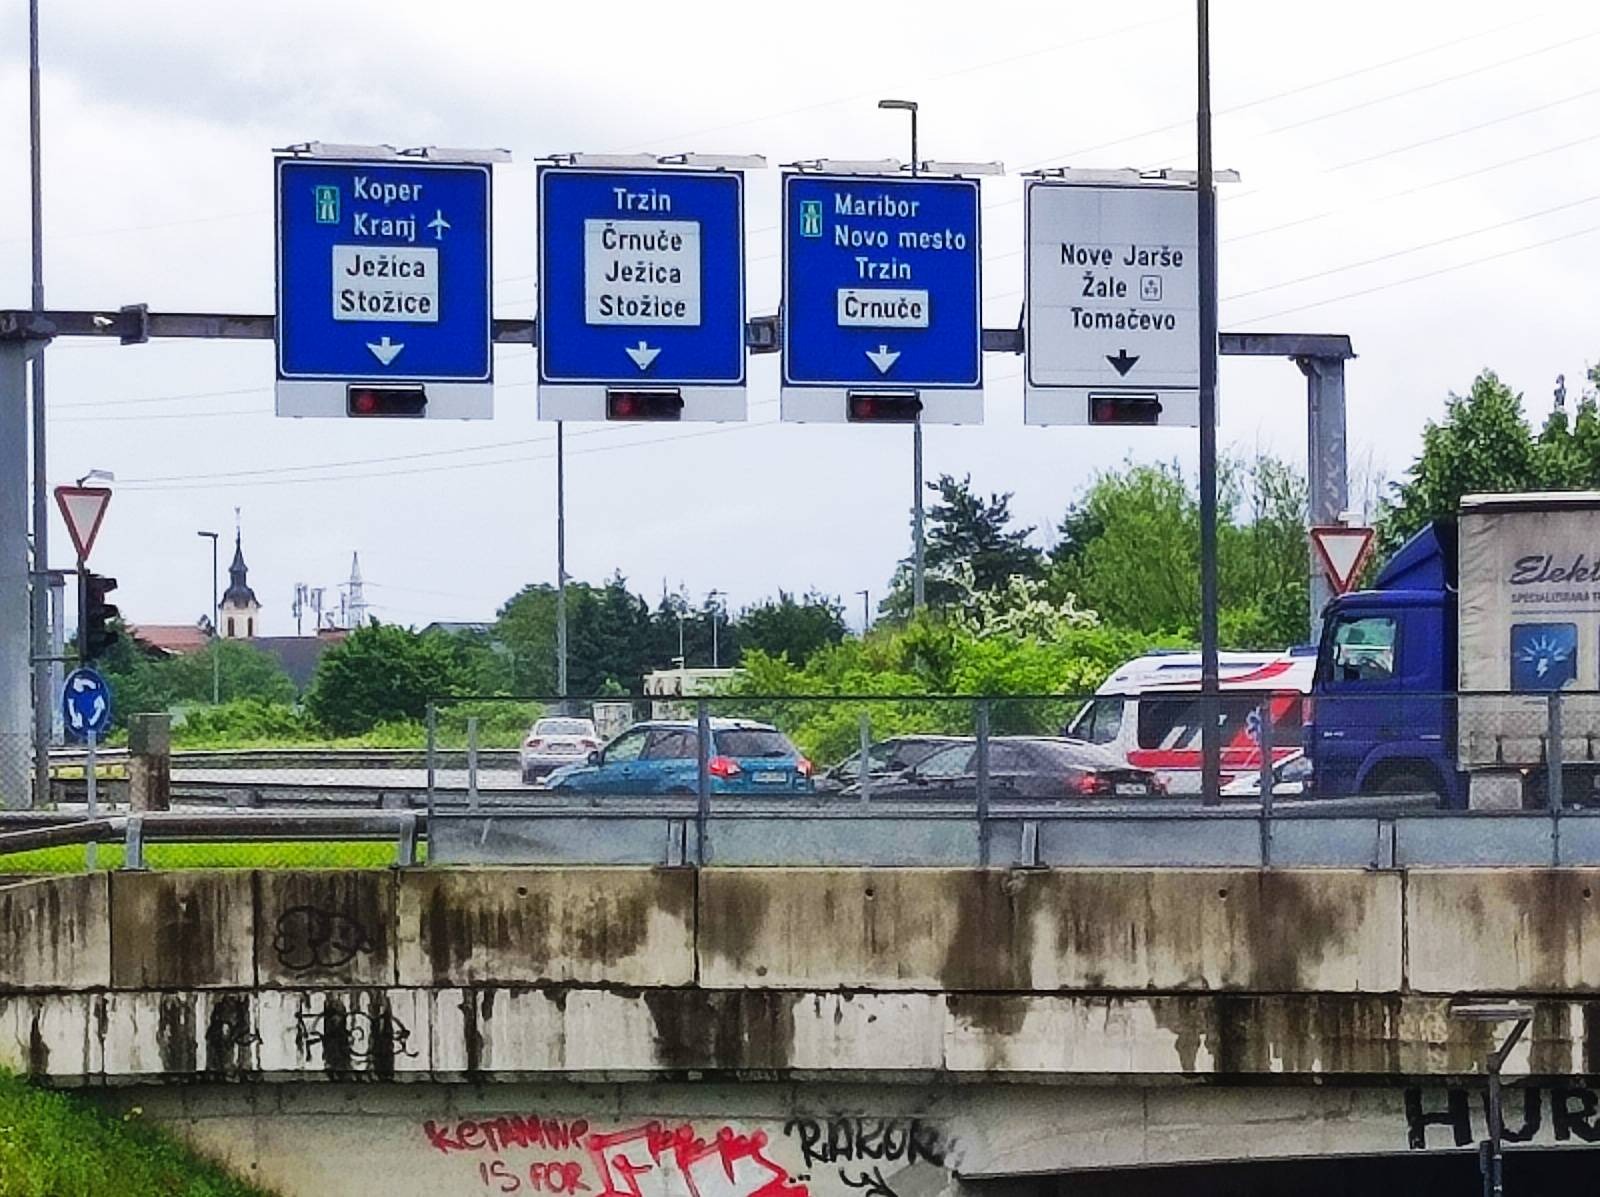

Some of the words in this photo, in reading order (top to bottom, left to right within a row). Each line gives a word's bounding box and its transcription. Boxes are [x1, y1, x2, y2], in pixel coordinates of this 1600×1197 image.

[354, 176, 422, 203] Koper
[613, 188, 671, 211] Trzin
[834, 193, 919, 217] Maribor
[353, 212, 416, 242] Kranj
[601, 222, 683, 252] Črnuče
[834, 224, 889, 249] Novo
[898, 228, 967, 250] mesto
[345, 254, 425, 278] Ježica
[855, 256, 911, 280] Trzin
[1060, 243, 1113, 267] Nove
[1122, 243, 1184, 268] Jarše
[604, 260, 682, 284] Ježica
[1081, 270, 1127, 298] Žale
[340, 288, 431, 314] Stožice
[599, 294, 686, 318] Stožice
[844, 290, 922, 320] Črnuče
[1070, 306, 1176, 331] Tomačevo
[479, 1160, 521, 1192] IS
[529, 1161, 592, 1195] FOR
